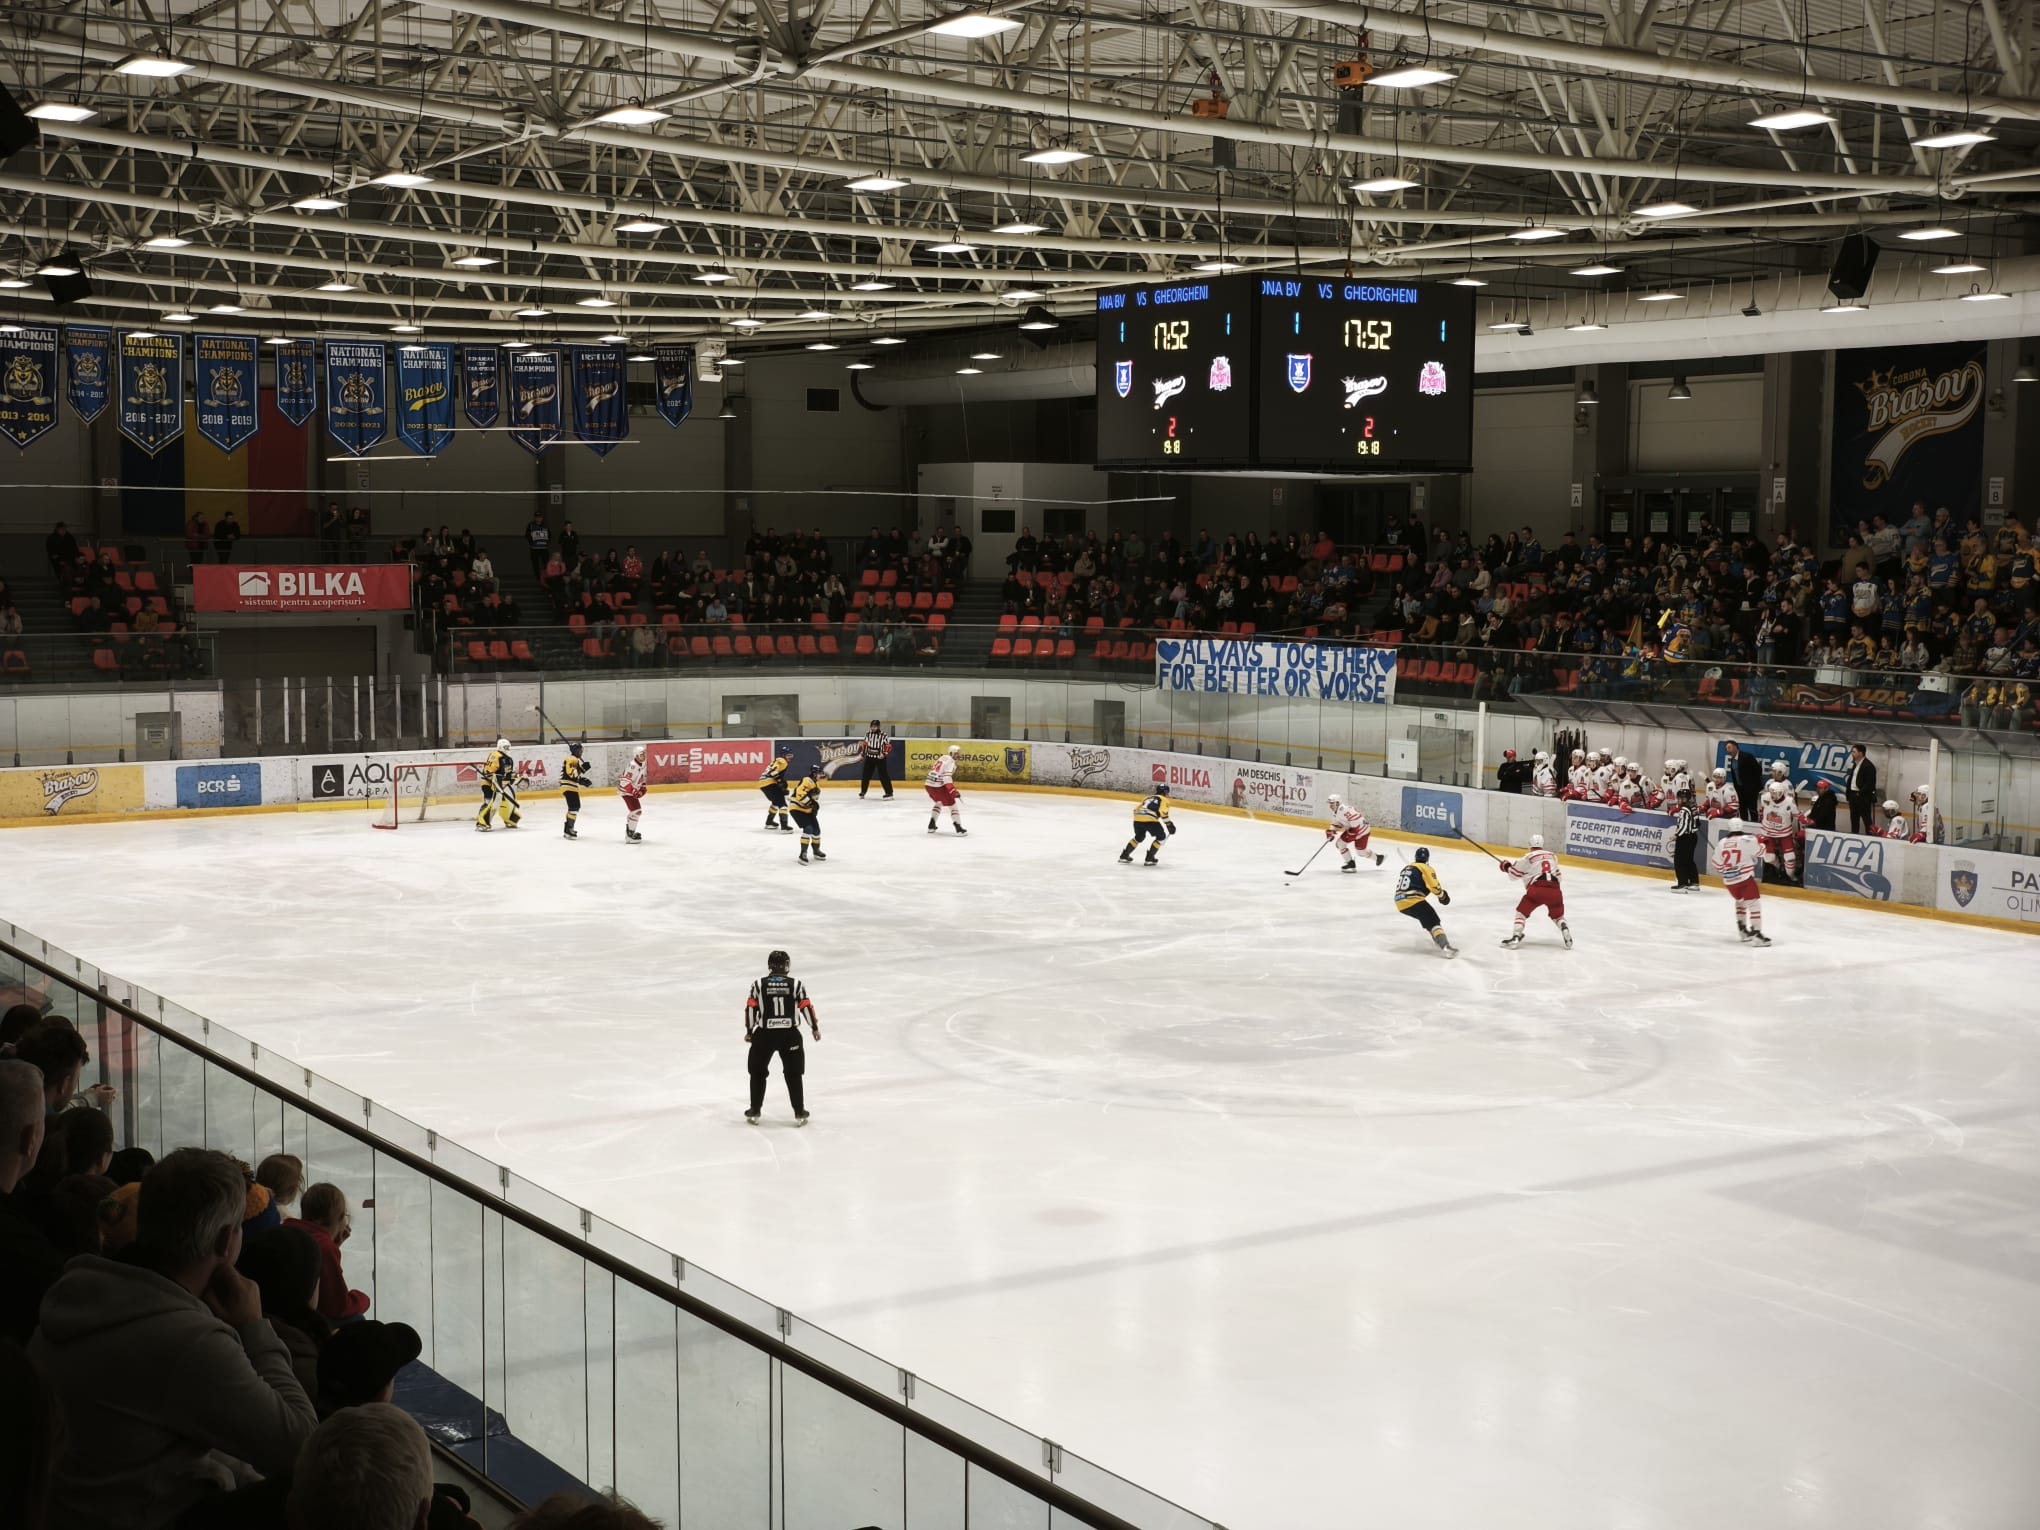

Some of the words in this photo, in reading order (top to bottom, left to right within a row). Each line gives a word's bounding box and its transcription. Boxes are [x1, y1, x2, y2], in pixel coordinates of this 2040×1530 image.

[1114, 294, 1126, 308] BV
[1136, 292, 1147, 306] VS
[1154, 285, 1209, 304] GHEORGHENI
[1286, 282, 1301, 297] BV
[1319, 284, 1333, 299] VS
[1344, 286, 1417, 303] GHEORGHENI
[0, 330, 55, 341] ATIONAL
[1154, 321, 1189, 350] 17:52
[1344, 319, 1392, 350] 17:52
[0, 340, 55, 352] HAMPIONS
[125, 336, 175, 348] NATIONAL
[202, 340, 249, 350] NATIONAL
[123, 347, 178, 359] CHAMPIONS
[199, 350, 253, 360] CHAMPIONS
[330, 346, 381, 357] NATIONAL
[403, 349, 446, 360] NATIONAL
[330, 357, 382, 368] CHAMPIONS
[403, 360, 447, 370] CHAMPIONS
[514, 365, 556, 373] CHAMPIONS
[1893, 368, 1927, 385] CORONA
[0, 411, 18, 420] 013
[28, 412, 50, 422] 2014
[125, 412, 147, 423] 2016
[155, 413, 177, 424] 2017
[202, 414, 223, 425] 2018
[231, 415, 252, 425] 2019
[1169, 417, 1177, 437] 2
[1364, 417, 1375, 437] 2
[1358, 440, 1379, 455] 19:18
[1573, 495, 1579, 505] A
[1776, 490, 1783, 501] A
[279, 572, 365, 596] BILKA
[244, 598, 278, 606] sisteme
[280, 598, 310, 608] pentru
[1181, 640, 1263, 667] ALWAYS
[1271, 643, 1377, 674] TOGETHER
[1159, 664, 1195, 691] FOR
[1204, 665, 1280, 696] BETTER
[1284, 669, 1311, 697] OR
[1317, 671, 1386, 704] WORSE
[654, 748, 764, 773] VIESSMANN
[348, 763, 420, 785] AQUA
[1171, 766, 1211, 788] BILKA
[1237, 768, 1249, 777] AM
[1250, 769, 1280, 782] DESCHIS
[198, 781, 225, 793] BCR
[348, 785, 422, 797] CARPAICA
[1415, 804, 1436, 820] BCR
[1570, 832, 1581, 842] DE
[1583, 834, 1612, 846] HOCHEI
[1613, 838, 1625, 848] PE
[1721, 849, 1742, 869] 27
[1807, 834, 1882, 873] LIGA
[2011, 870, 2040, 892] PA
[772, 996, 785, 1017] 11
